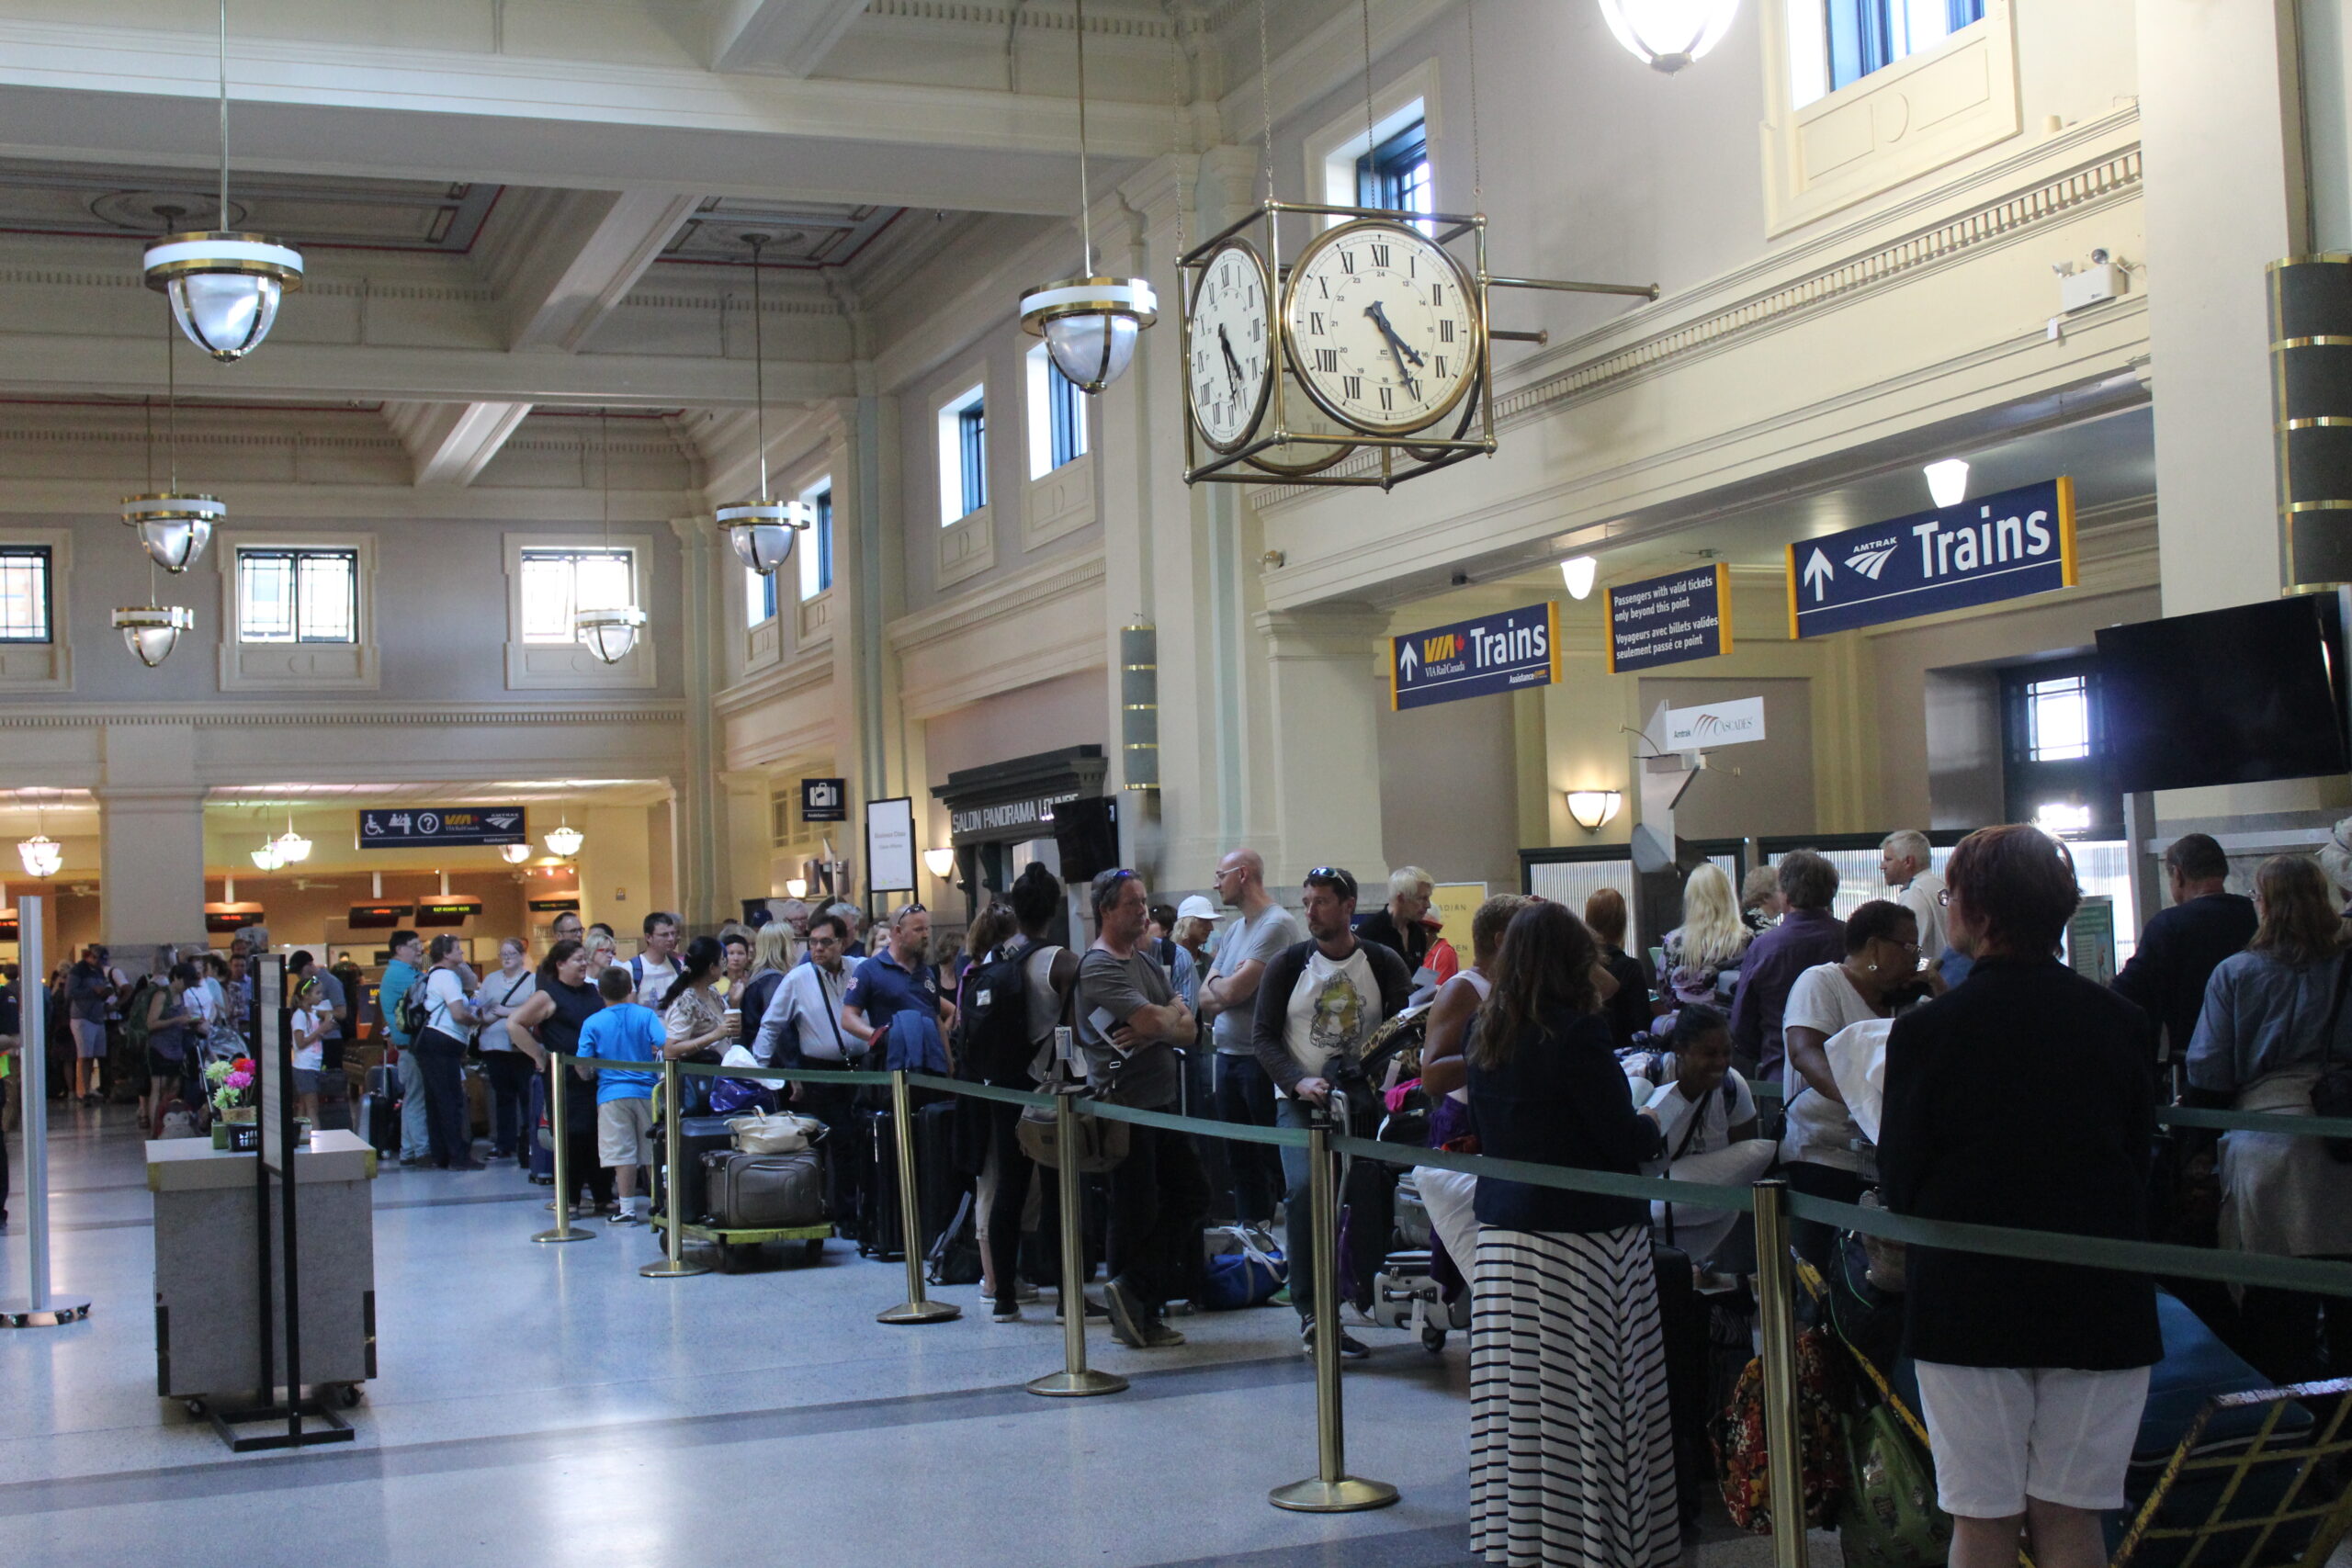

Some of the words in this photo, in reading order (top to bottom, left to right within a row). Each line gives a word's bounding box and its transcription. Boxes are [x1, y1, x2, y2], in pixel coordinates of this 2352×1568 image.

[1340, 252, 1353, 275] XI
[1371, 244, 1389, 267] XII
[1410, 255, 1416, 278] I
[1318, 276, 1329, 299] X
[1432, 283, 1442, 306] II
[1310, 311, 1325, 335] IX
[1440, 320, 1453, 343] III
[1315, 349, 1338, 372] VIII
[1435, 355, 1448, 378] IV
[1343, 376, 1361, 400] VII
[1378, 387, 1393, 411] VI
[1414, 379, 1423, 402] V
[1853, 536, 1897, 554] AMTRAK
[1912, 505, 2051, 579] Trains
[1614, 591, 1652, 606] Passengers
[1653, 585, 1668, 598] with
[1669, 581, 1687, 594] valid
[1688, 576, 1713, 591] tickets
[1614, 609, 1629, 622] only
[1630, 604, 1655, 620] beyond
[1657, 601, 1670, 613] this
[1671, 596, 1690, 613] point
[1616, 630, 1650, 646] Voyageurs
[1652, 626, 1668, 637] avec
[1668, 621, 1691, 634] billets
[1692, 615, 1719, 629] valides
[1424, 634, 1455, 663] VIA
[1470, 617, 1547, 669] Trains
[1616, 642, 1652, 660] seulement
[1653, 638, 1673, 656] passé
[1674, 639, 1683, 649] ce
[1684, 634, 1702, 649] point
[1425, 665, 1436, 678] VIA
[1436, 663, 1447, 675] Rail
[1446, 660, 1465, 674] Canada
[1509, 671, 1534, 684] Assistance
[953, 809, 983, 833] SALON
[983, 800, 1036, 829] PANORAMA
